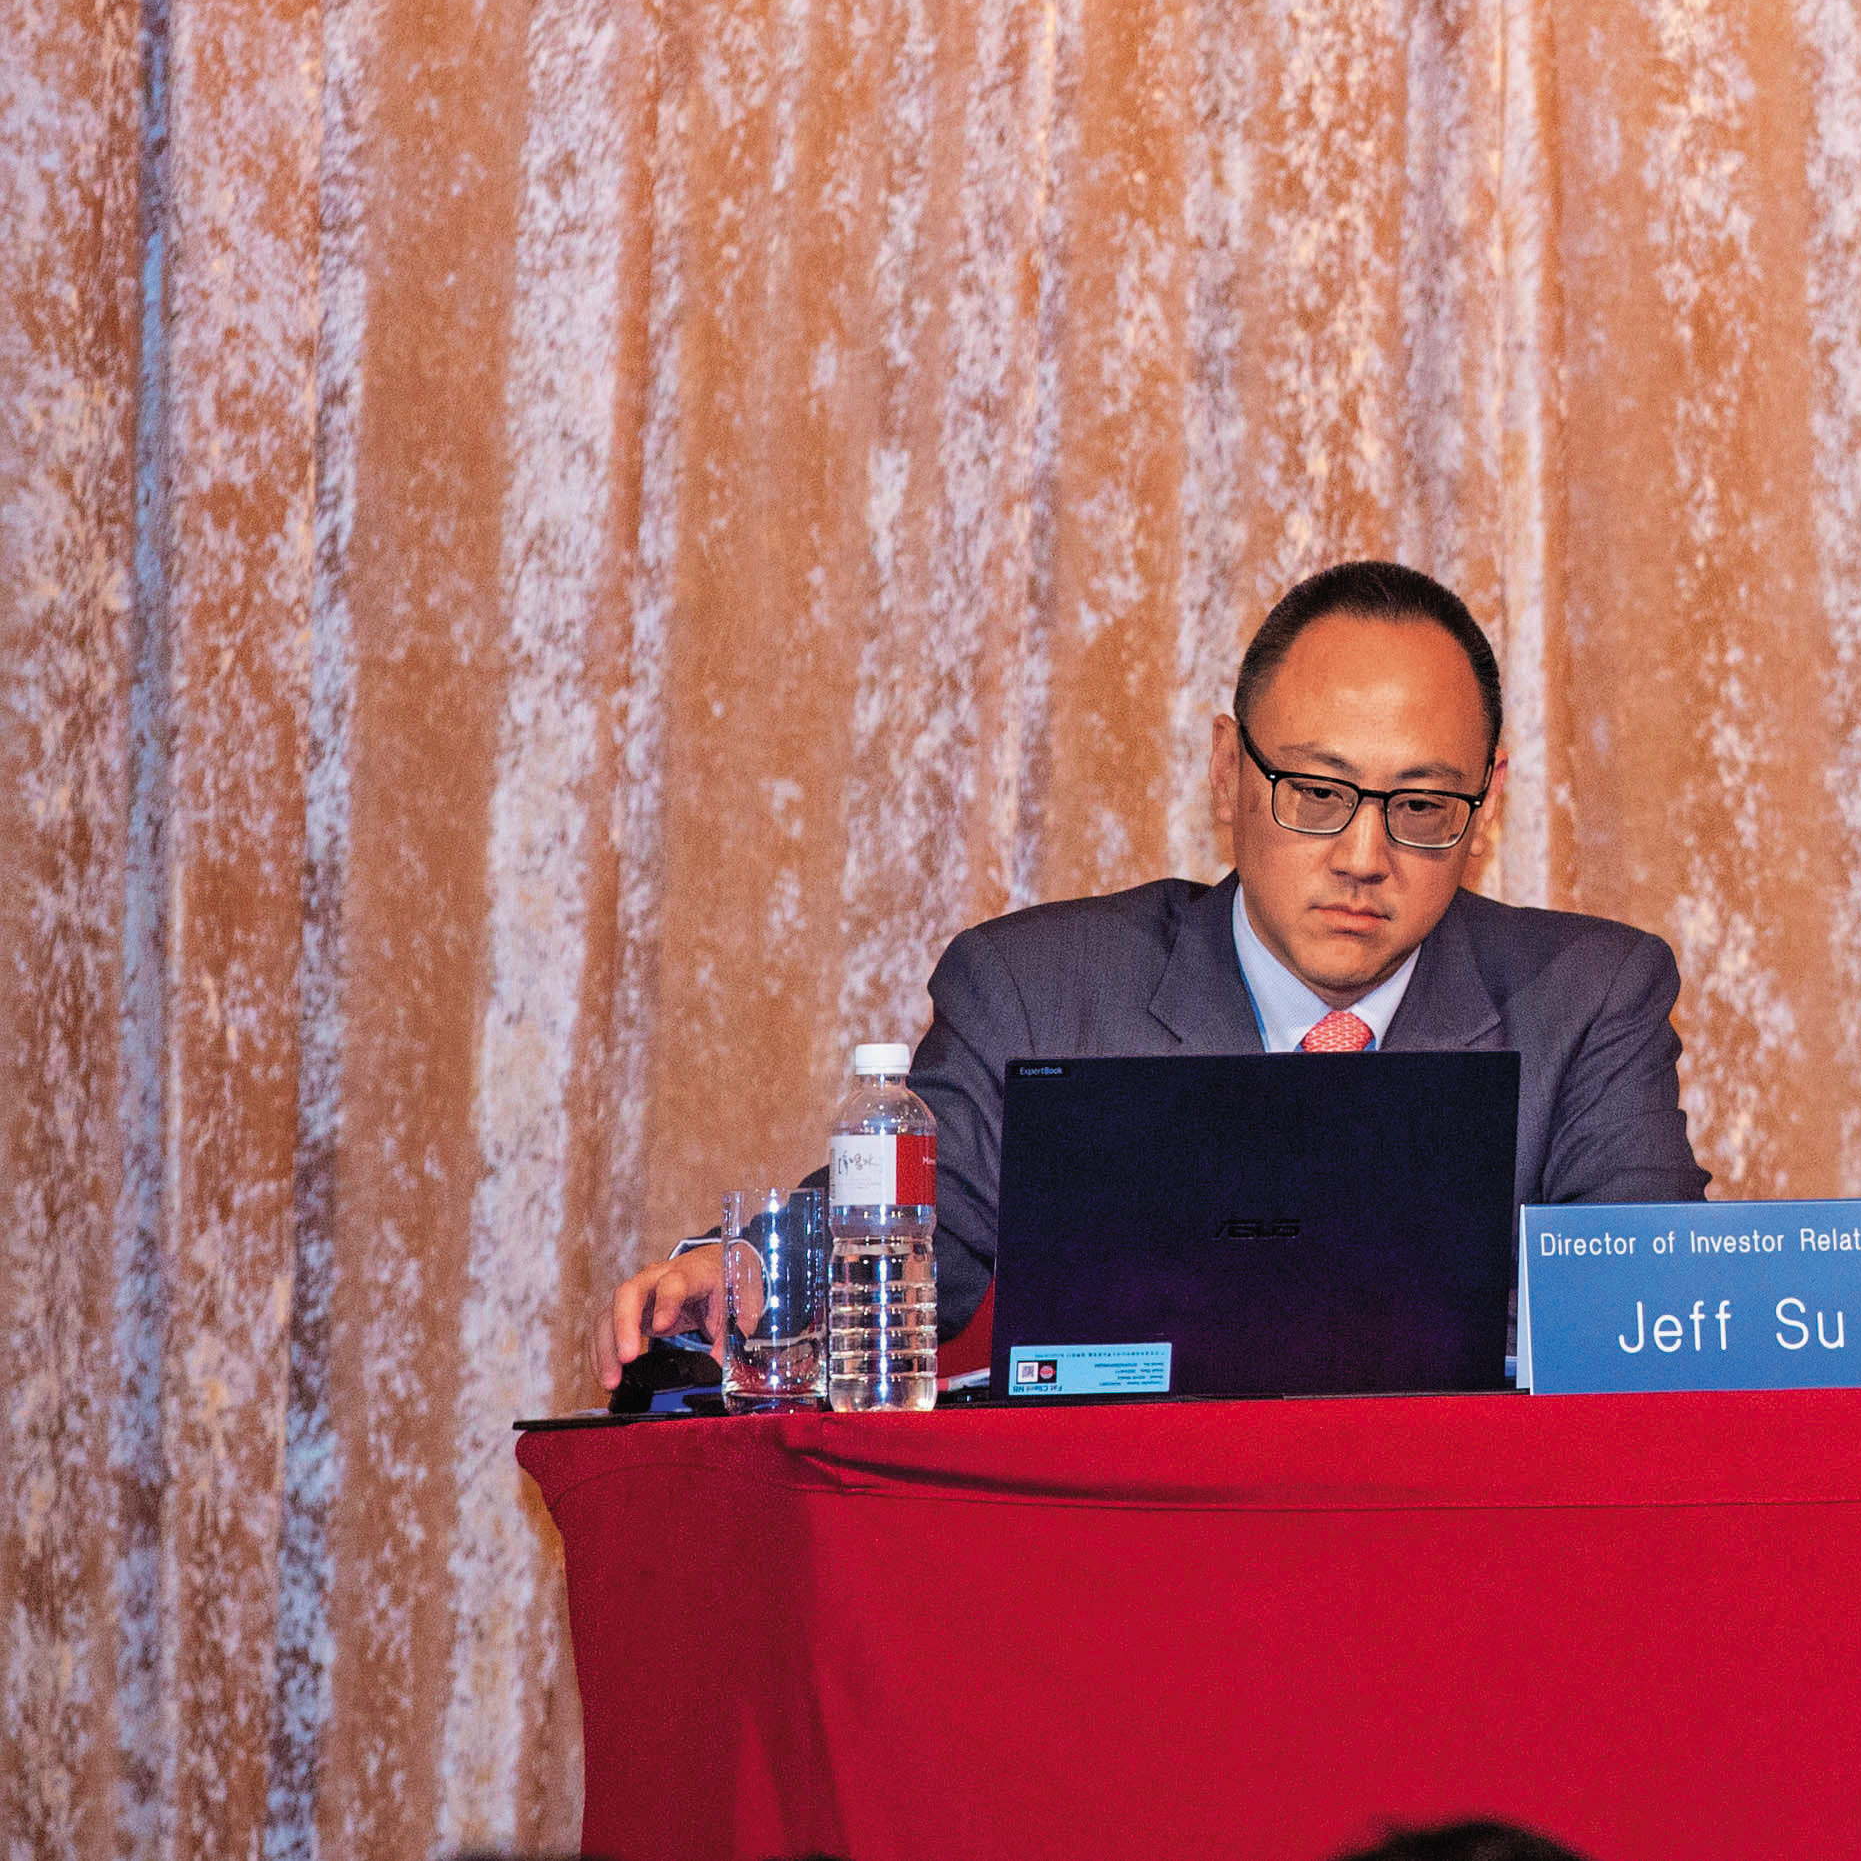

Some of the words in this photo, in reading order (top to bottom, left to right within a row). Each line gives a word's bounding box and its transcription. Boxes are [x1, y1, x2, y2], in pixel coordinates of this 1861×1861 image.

[1020, 1067, 1063, 1075] ExpertBook
[1540, 1232, 1636, 1257] Director
[1652, 1230, 1676, 1255] of
[1690, 1229, 1785, 1254] Investor
[1618, 1300, 1732, 1355] Jeff
[1775, 1297, 1845, 1350] Su
